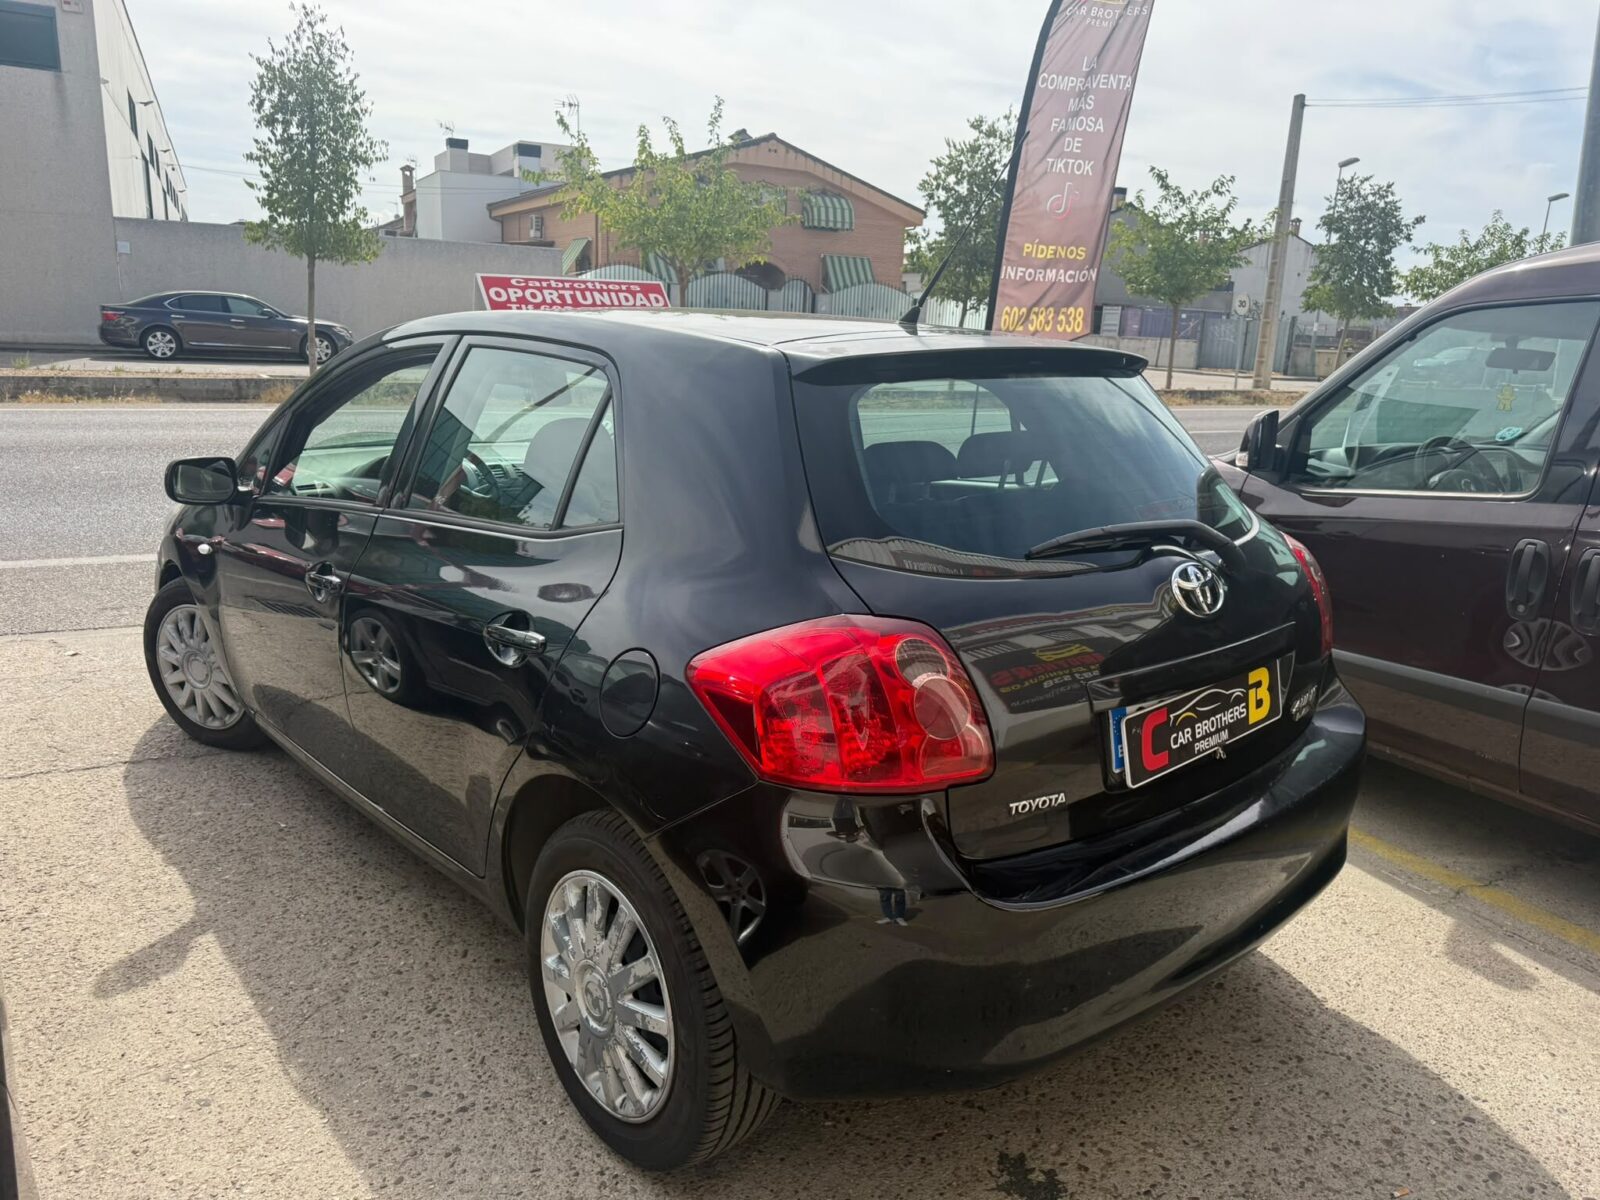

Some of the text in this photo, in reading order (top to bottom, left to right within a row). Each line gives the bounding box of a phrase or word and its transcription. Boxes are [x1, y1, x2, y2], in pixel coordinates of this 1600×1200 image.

[1090, 6, 1149, 19] BROTERS
[1082, 56, 1098, 71] LA
[1038, 73, 1133, 92] COMPRAVENTA
[1051, 116, 1105, 132] FAMOSA
[1064, 137, 1083, 152] DE
[1046, 158, 1094, 175] TIKTOK
[1022, 239, 1087, 260] PÍDENOS
[1000, 265, 1098, 283] INFORMACIÓN
[488, 287, 665, 307] OPORTUNIDAD
[1000, 305, 1085, 333] 602 583 538
[1170, 703, 1247, 749] CAR BROTHERS
[1194, 729, 1229, 754] PREMIUM
[1009, 793, 1066, 816] TOYOTA
